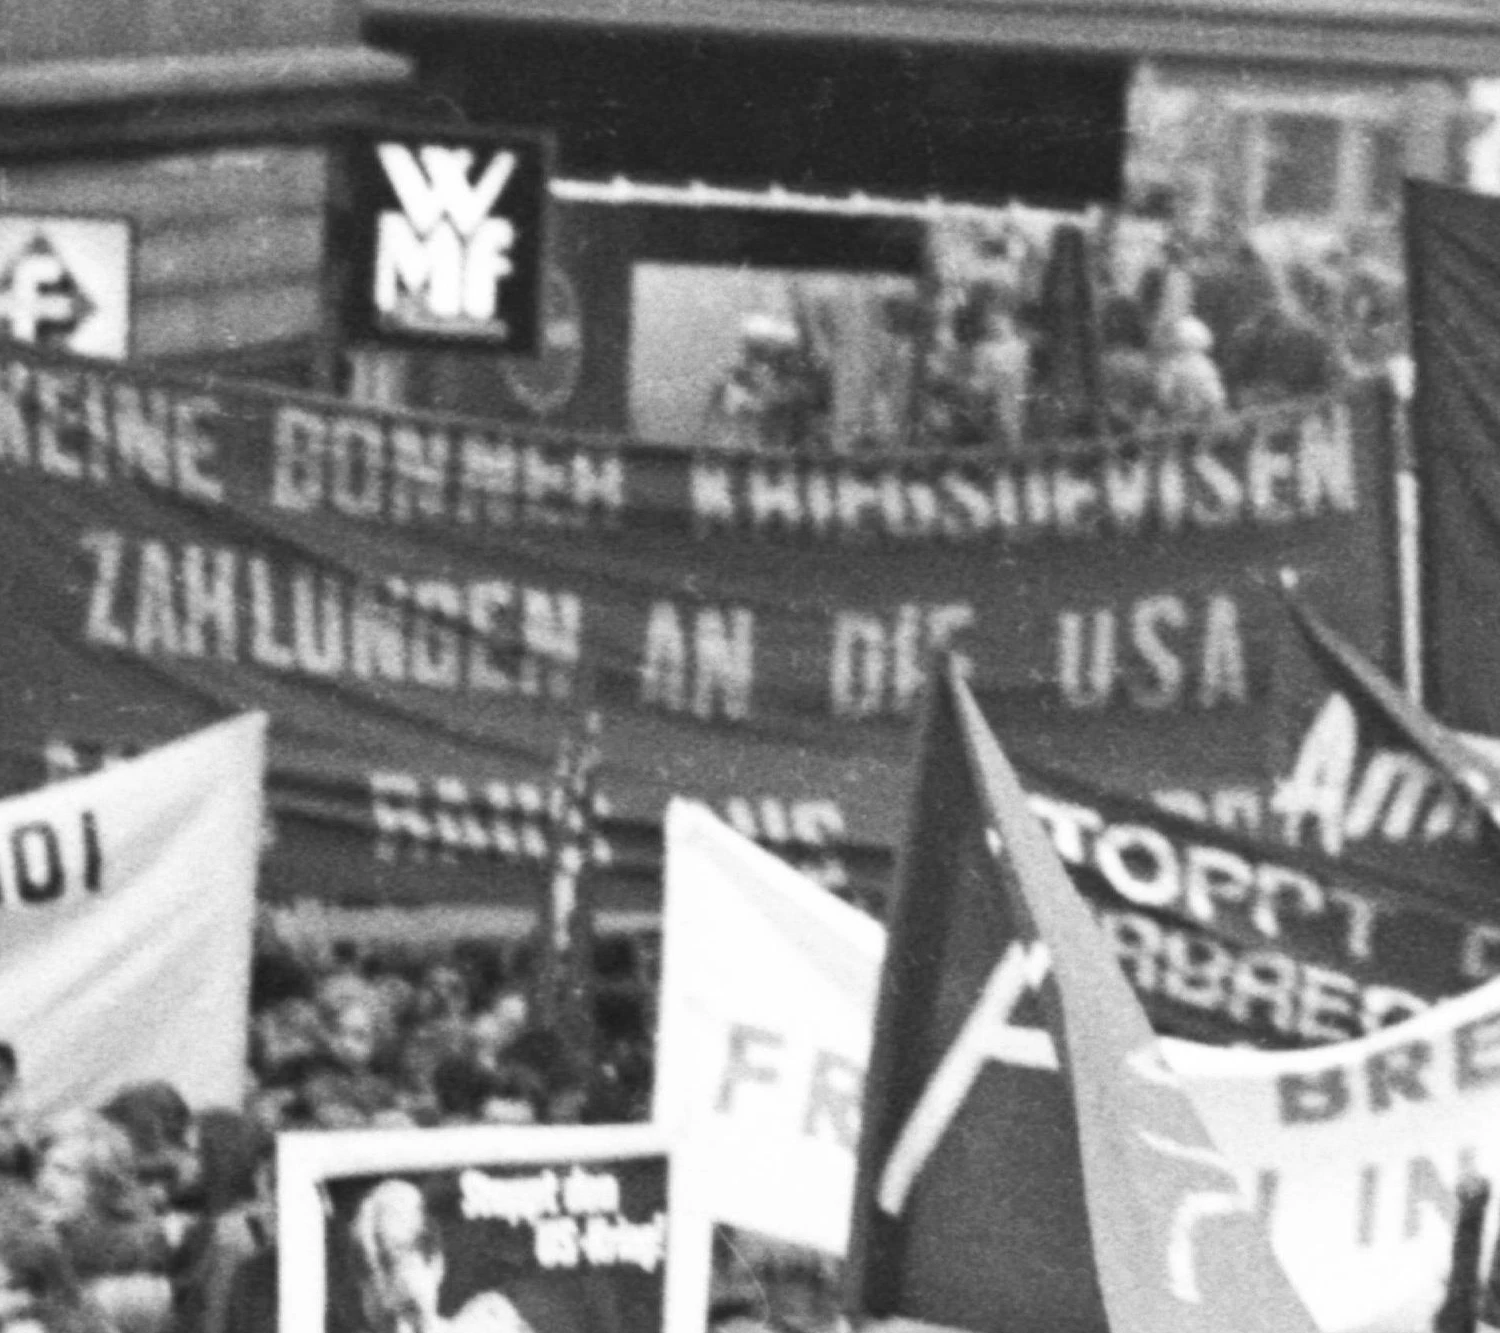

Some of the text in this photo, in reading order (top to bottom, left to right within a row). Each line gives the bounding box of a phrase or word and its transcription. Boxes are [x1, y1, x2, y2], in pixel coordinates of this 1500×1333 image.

[642, 602, 756, 722] AN
[1056, 593, 1248, 712] USA
[1035, 788, 1376, 962] TOPPT
